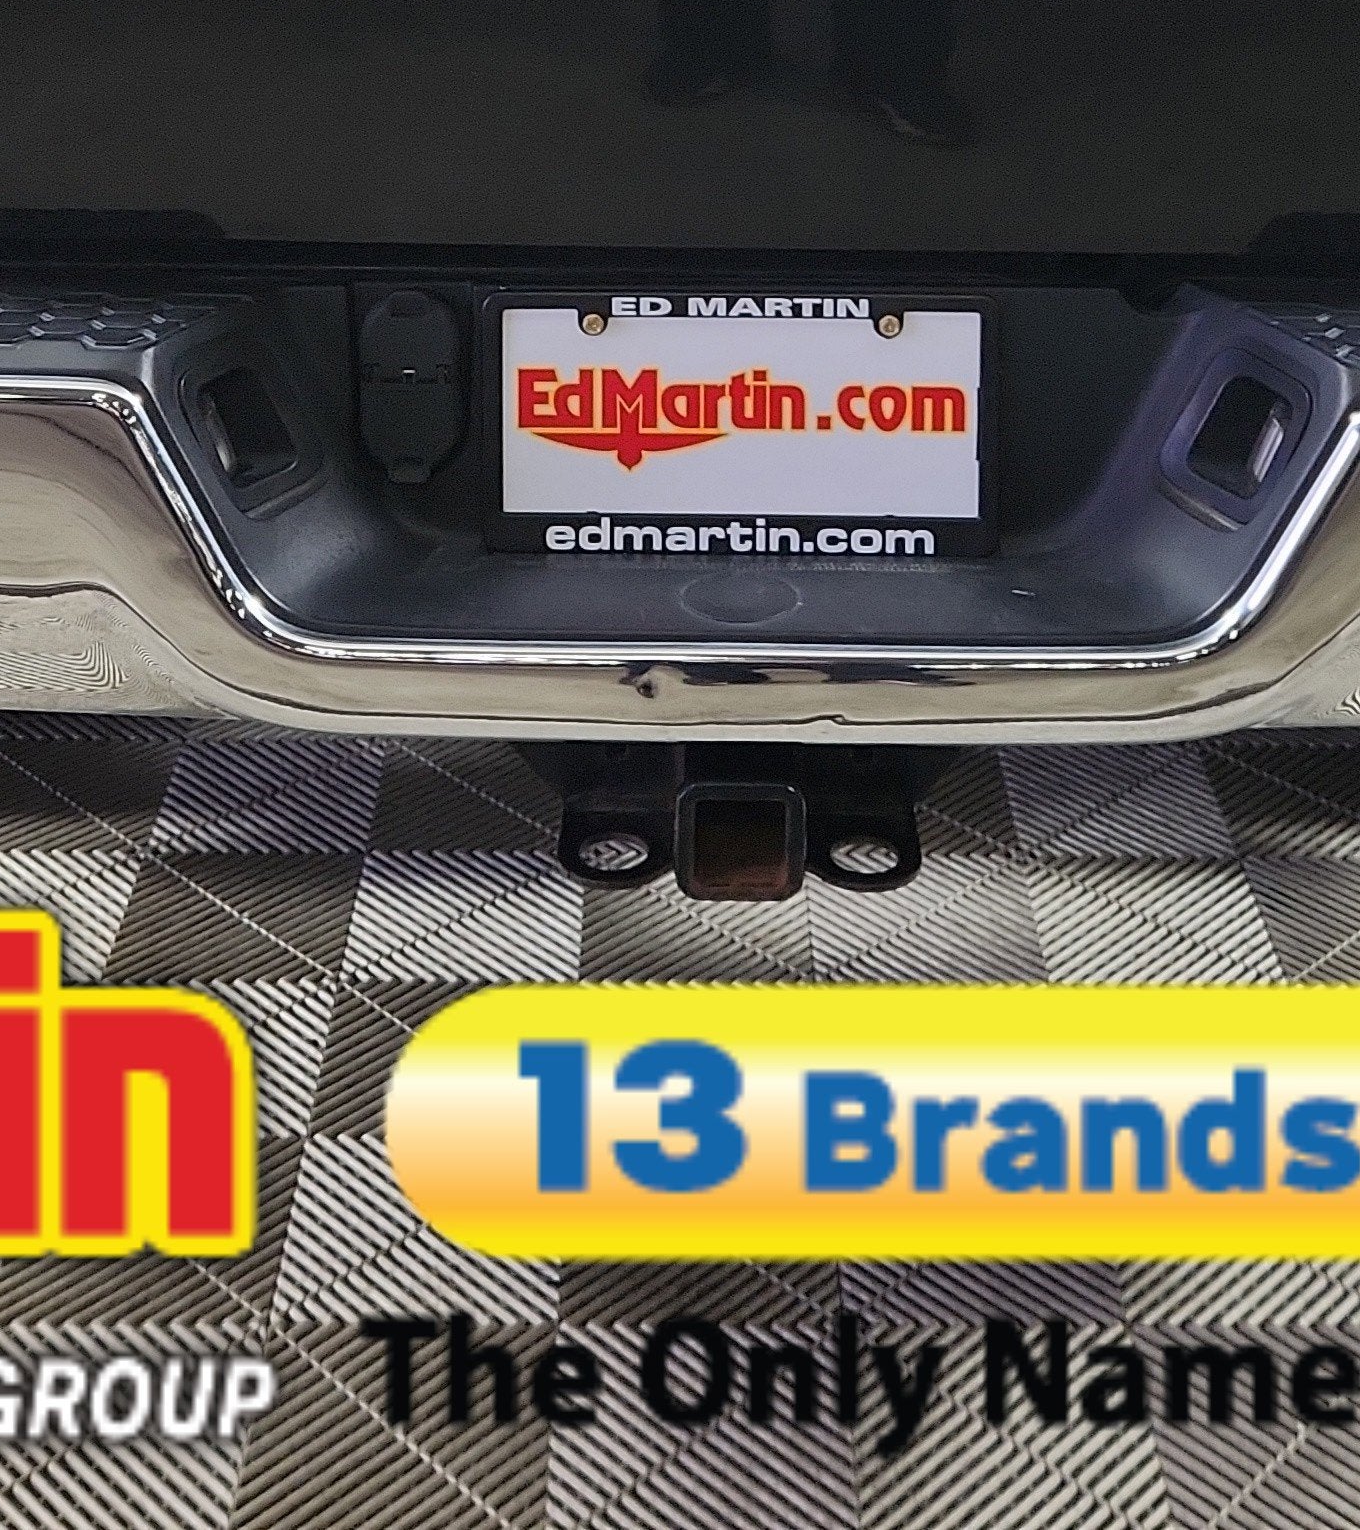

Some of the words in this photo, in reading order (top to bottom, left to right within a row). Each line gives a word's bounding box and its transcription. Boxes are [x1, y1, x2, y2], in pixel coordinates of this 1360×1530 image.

[611, 296, 672, 317] ED
[687, 297, 870, 319] MARTIN
[545, 517, 936, 555] edmartin.com
